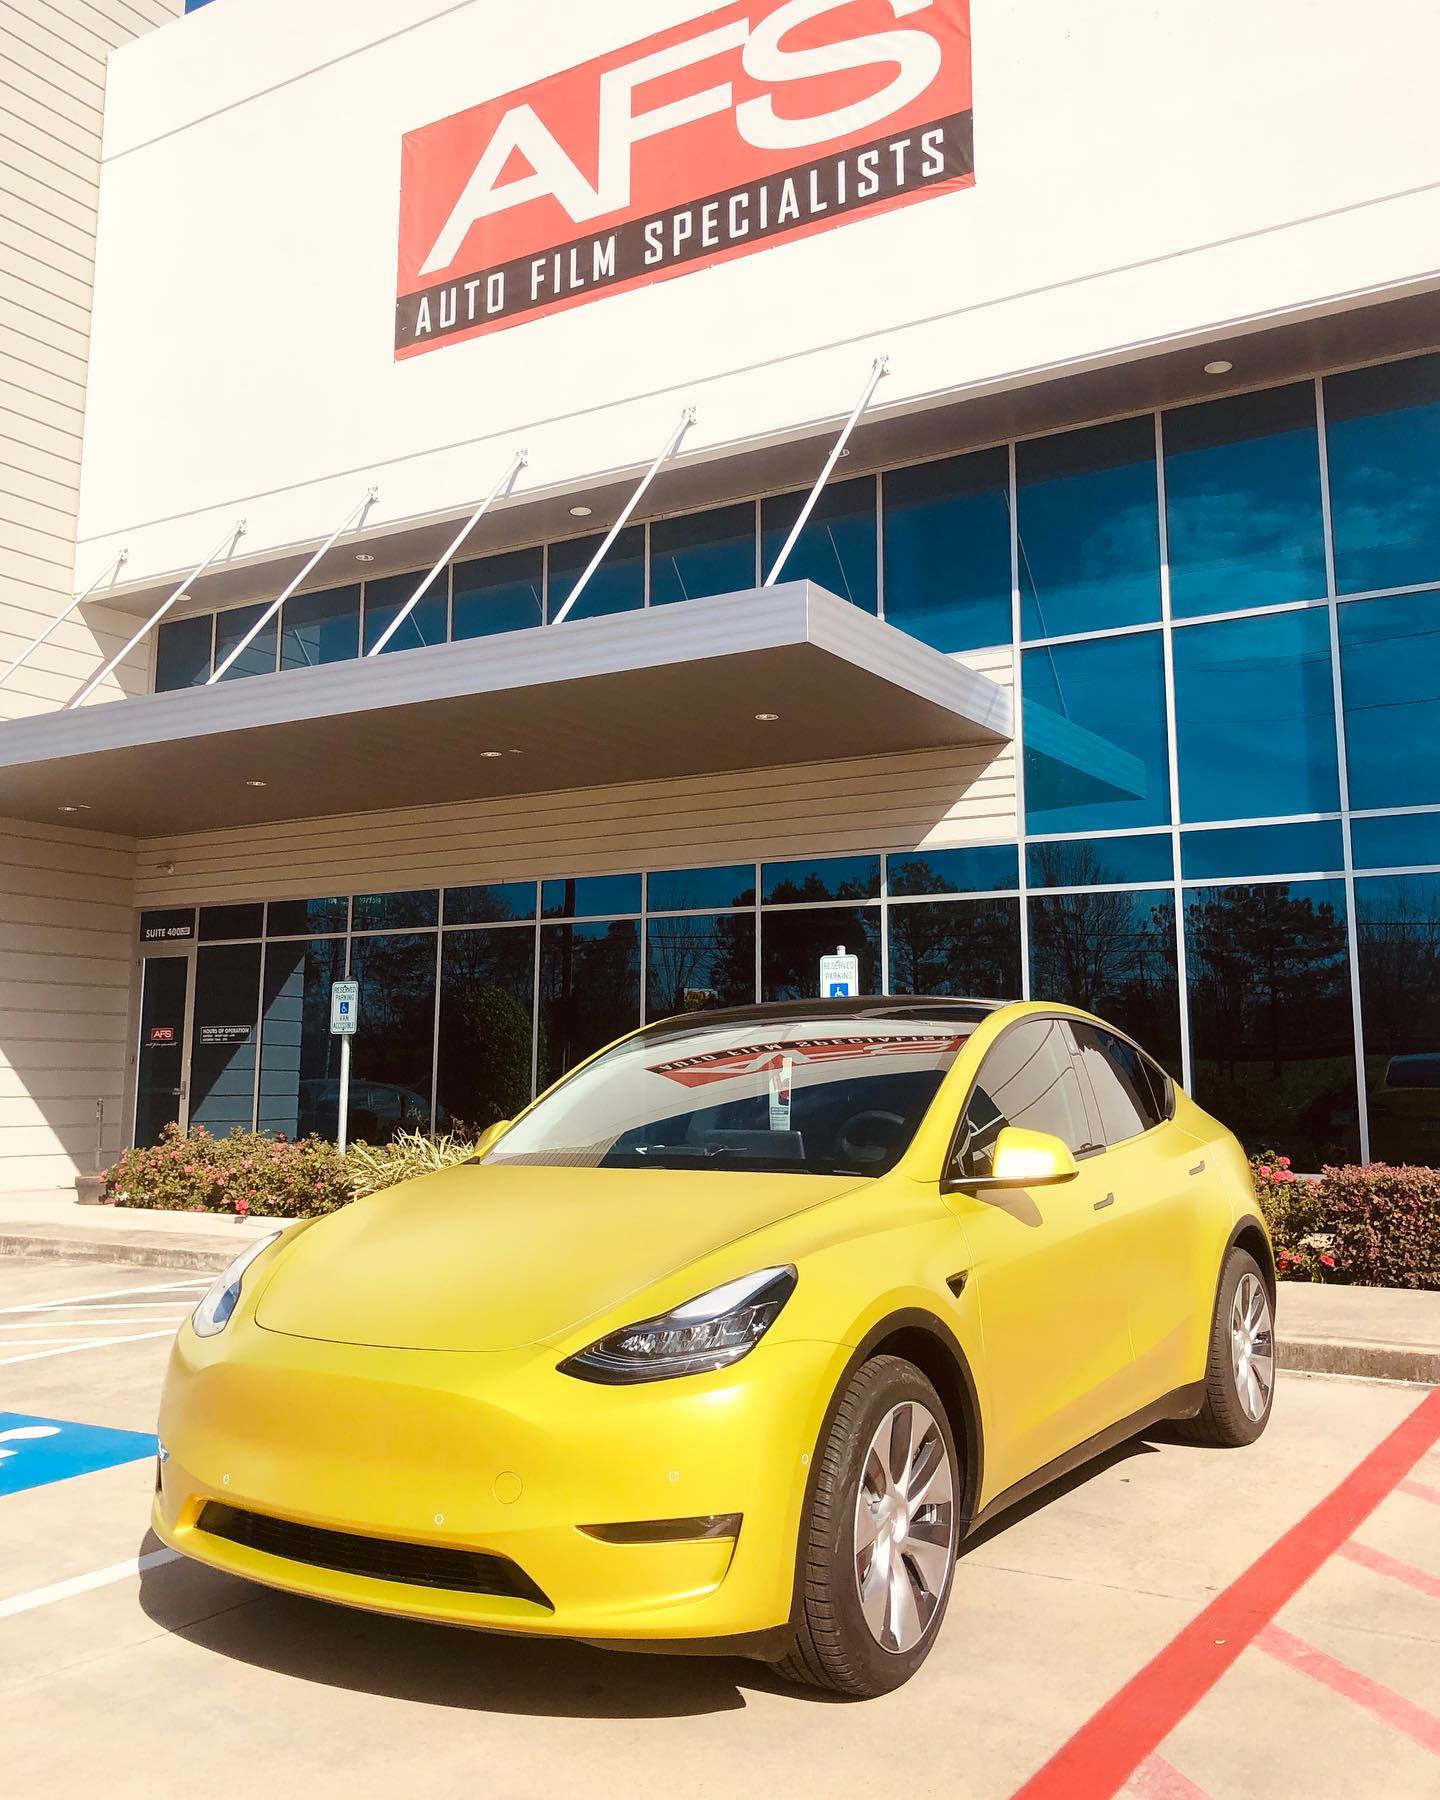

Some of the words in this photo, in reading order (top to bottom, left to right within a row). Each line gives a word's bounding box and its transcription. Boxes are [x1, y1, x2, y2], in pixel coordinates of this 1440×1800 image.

[417, 0, 942, 277] AFS
[414, 271, 505, 337] AUTO
[530, 235, 616, 300] FILM
[644, 128, 945, 265] SPECIALISTS
[145, 929, 165, 938] SUITE
[167, 927, 180, 937] 400
[824, 961, 854, 970] RESERVED
[825, 972, 852, 980] PARKING
[153, 1030, 172, 1038] AFS
